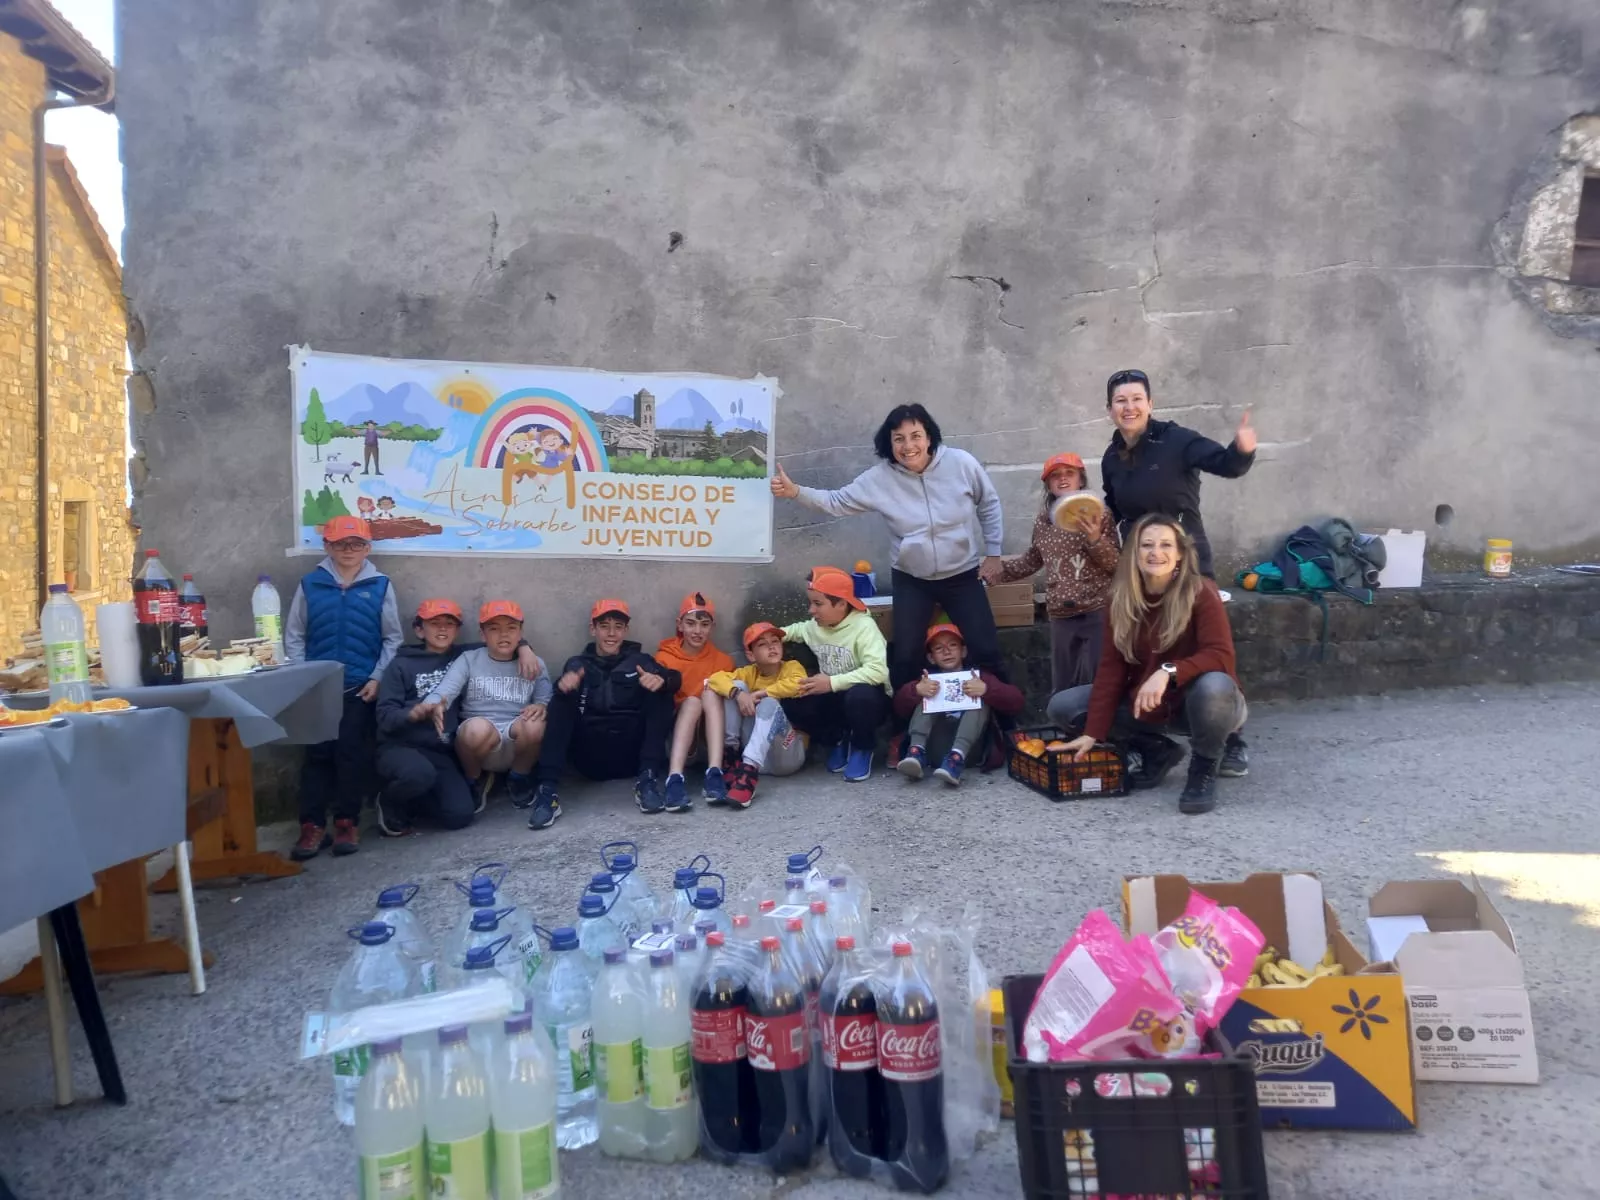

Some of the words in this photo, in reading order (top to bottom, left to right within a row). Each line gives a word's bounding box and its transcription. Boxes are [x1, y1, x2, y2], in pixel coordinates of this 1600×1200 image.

[581, 481, 697, 503] CONSEJO
[704, 485, 736, 503] DE
[456, 503, 577, 537] Sobrarbe
[582, 504, 698, 525] INFANCIA
[704, 508, 721, 525] Y
[581, 529, 713, 548] JUVENTUD
